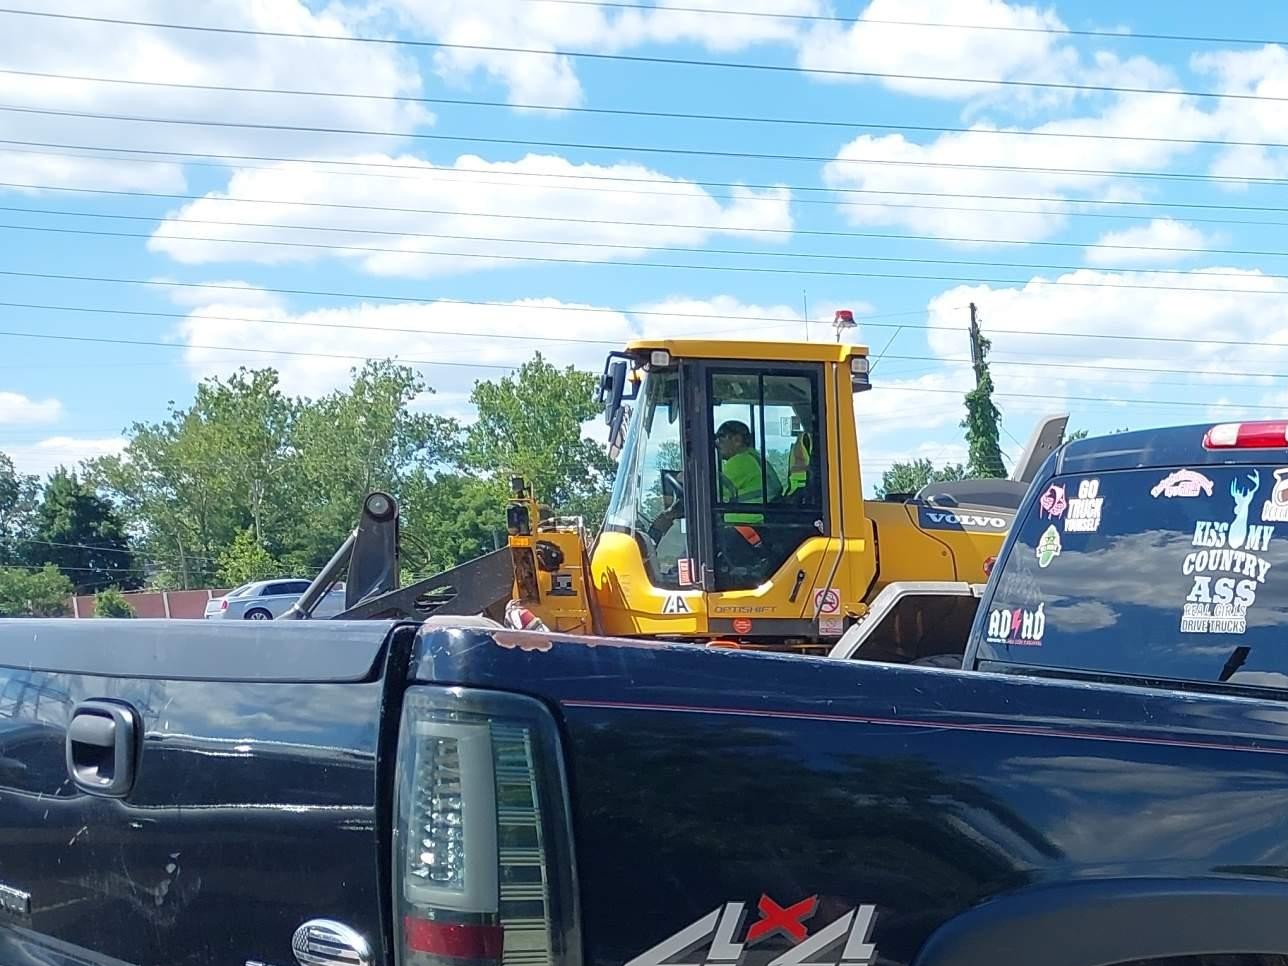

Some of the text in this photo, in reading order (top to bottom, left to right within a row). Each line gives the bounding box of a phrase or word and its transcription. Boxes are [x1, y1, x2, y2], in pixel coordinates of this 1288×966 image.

[1079, 480, 1099, 499] GO
[1068, 498, 1103, 519] TRUCK
[926, 512, 1006, 528] VOLVO
[1192, 520, 1275, 551] KISS MY
[1183, 549, 1271, 583] COUNTRY
[1186, 576, 1257, 607] ASS
[714, 606, 777, 614] OPTISHIFT
[1184, 603, 1246, 618] REAL GIRLS
[1182, 618, 1246, 633] DRIVE TRUCKS
